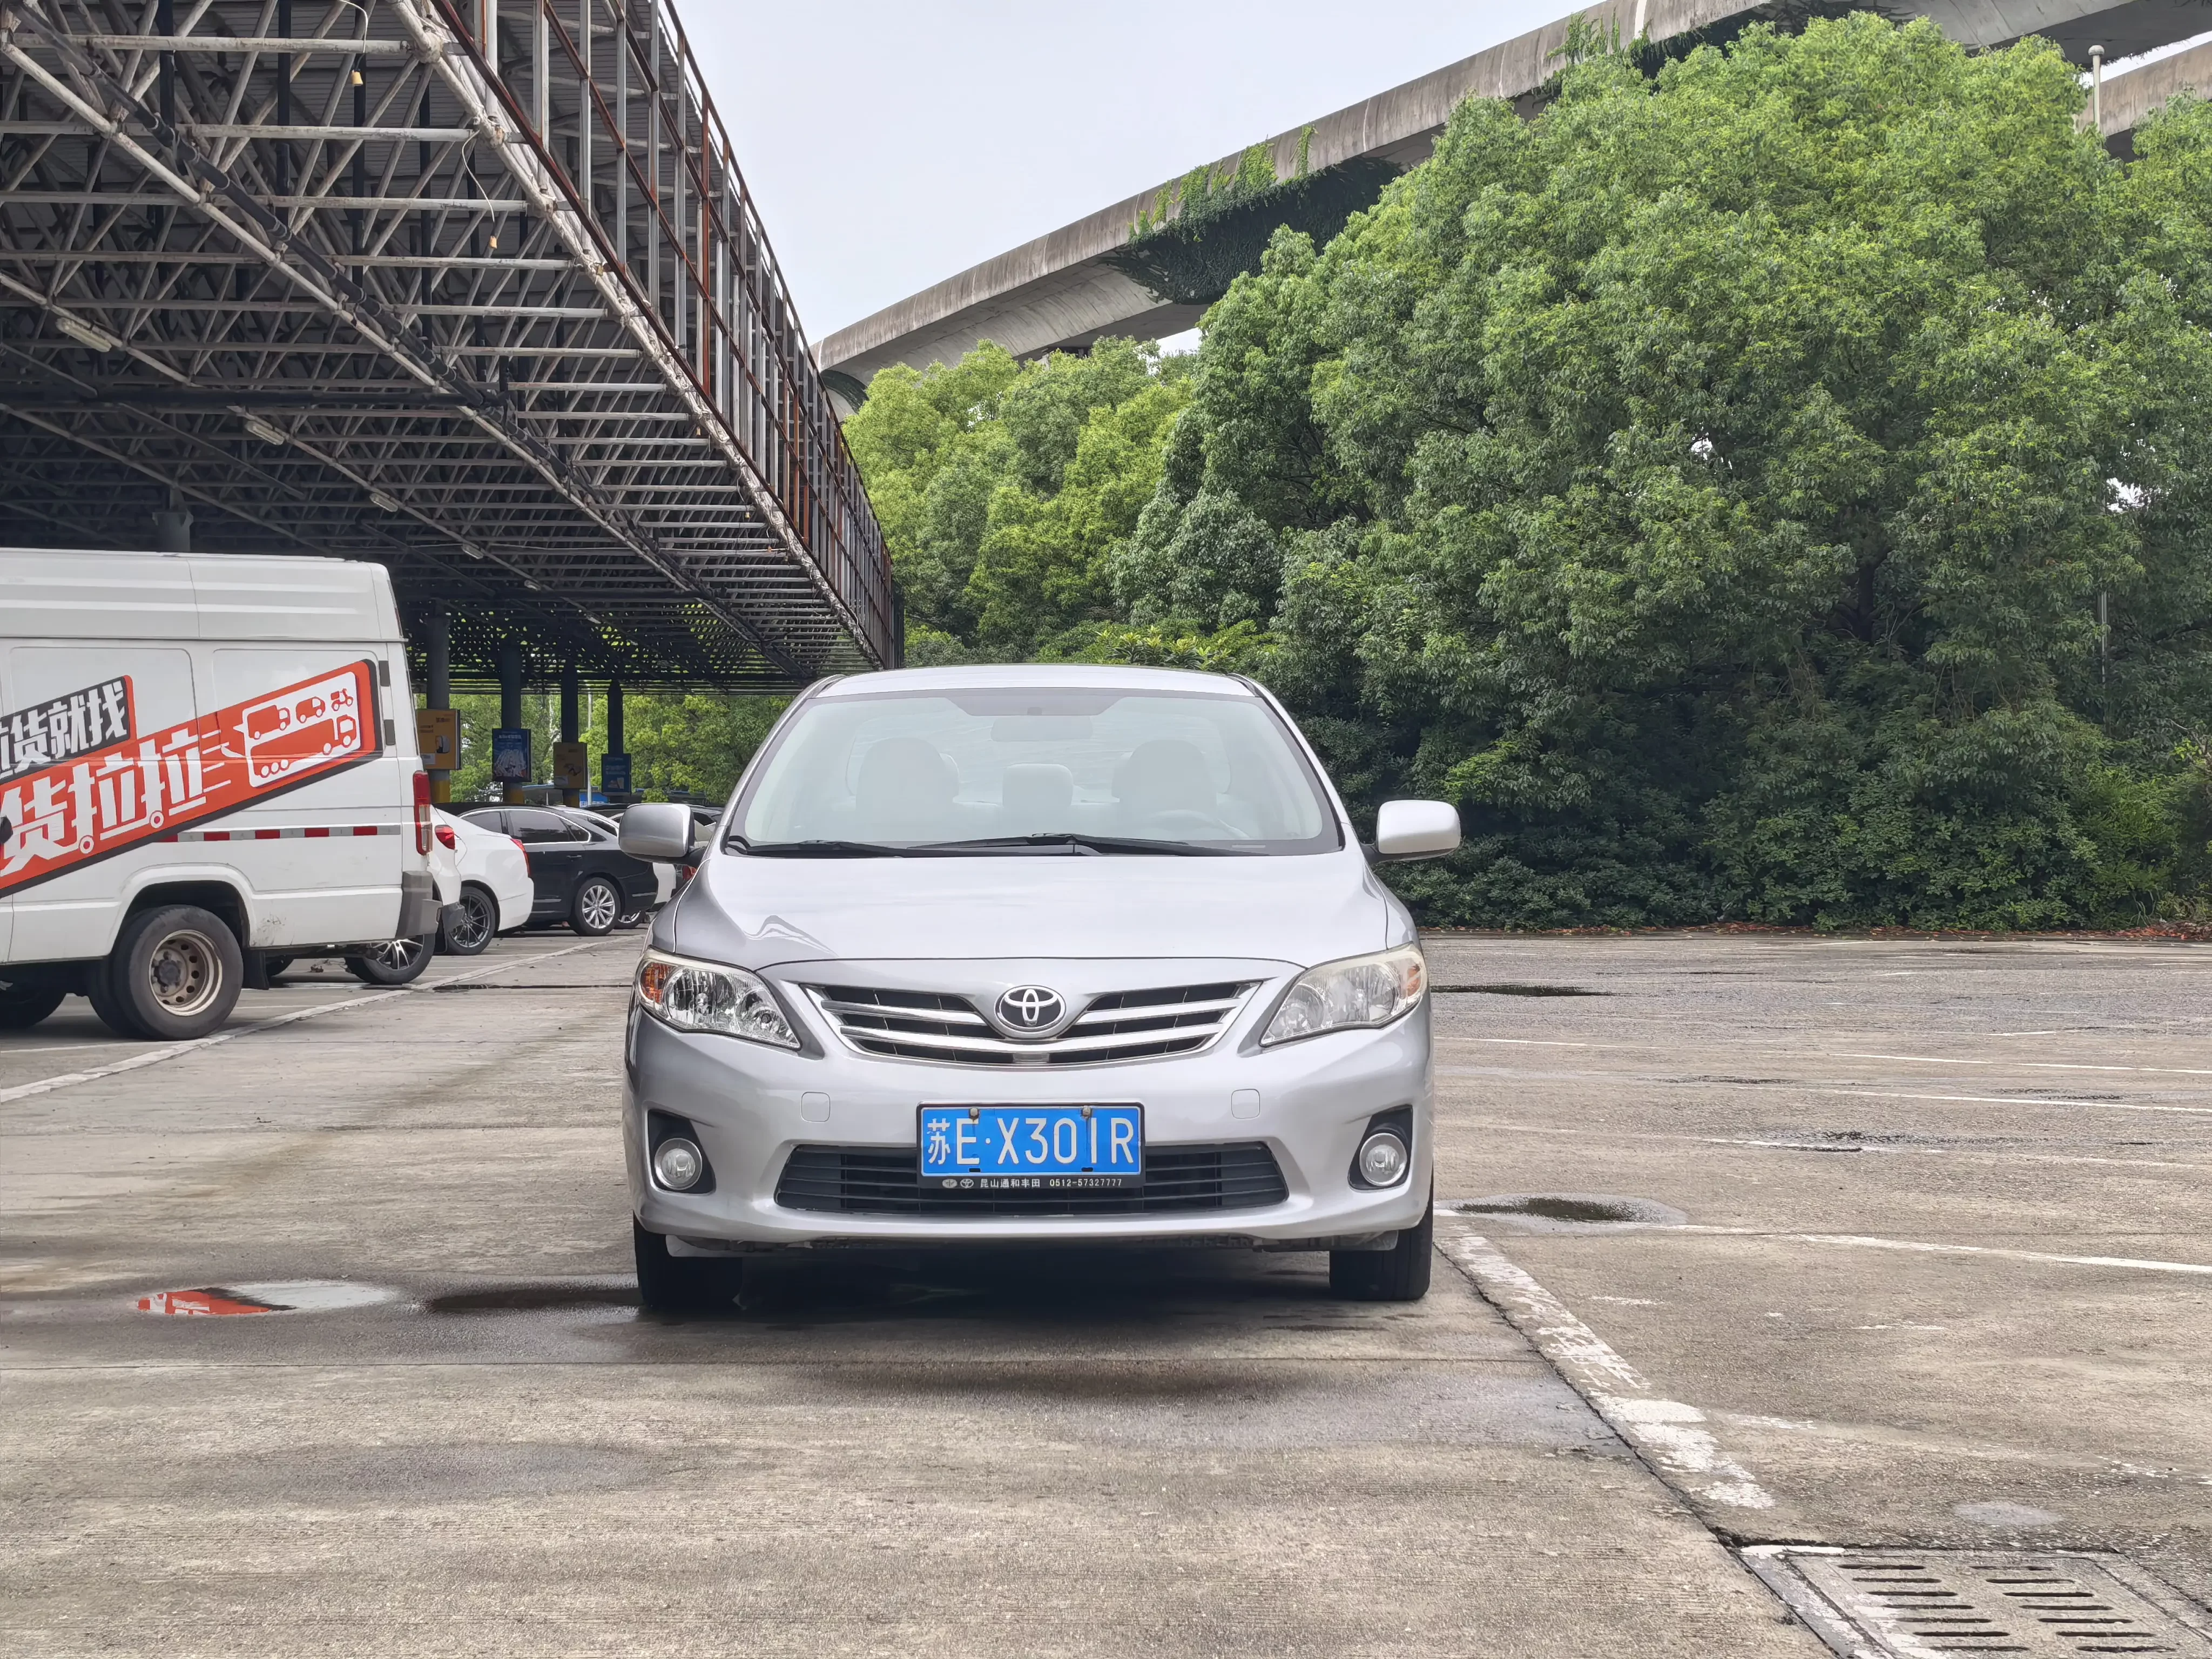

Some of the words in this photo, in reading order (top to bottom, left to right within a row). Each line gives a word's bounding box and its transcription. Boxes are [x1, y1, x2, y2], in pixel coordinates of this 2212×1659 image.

[0, 680, 127, 779] 货就找
[0, 729, 206, 876] 货拉拉
[980, 1178, 1041, 1188] 昆山通和丰田
[1049, 1178, 1122, 1188] 0512-57327777
